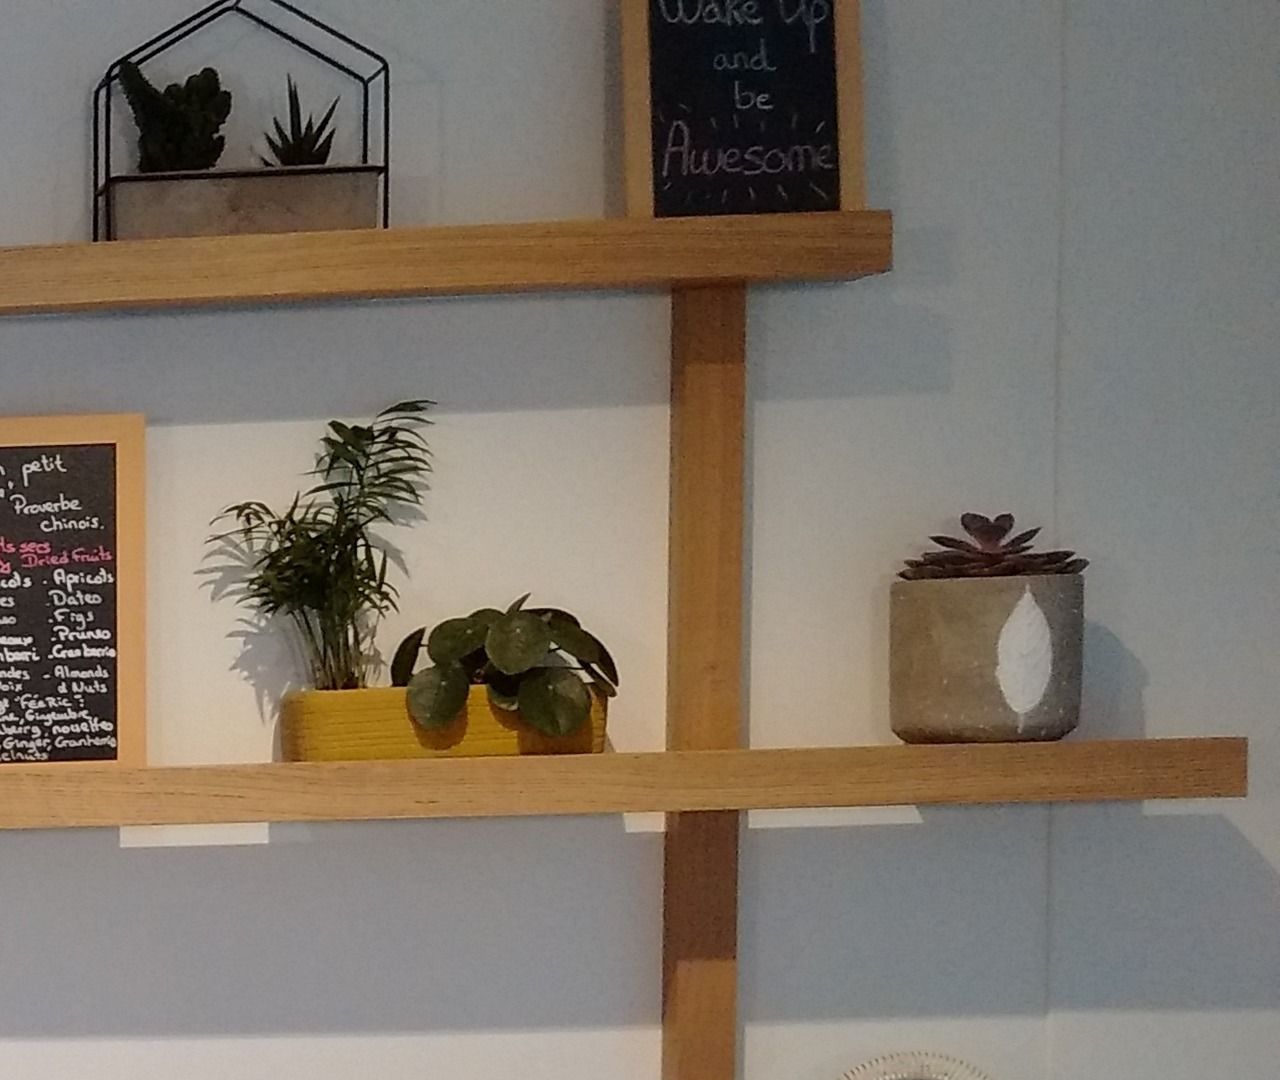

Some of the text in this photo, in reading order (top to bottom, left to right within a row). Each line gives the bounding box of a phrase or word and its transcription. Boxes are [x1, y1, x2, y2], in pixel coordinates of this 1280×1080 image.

[660, 0, 762, 26] Wake
[712, 38, 777, 72] and
[734, 80, 776, 110] be
[662, 119, 834, 177] Awesome
[22, 454, 67, 487] petit
[9, 493, 83, 515] Proverbe
[18, 541, 52, 554] secs
[21, 545, 114, 568] Dried Fruits
[53, 568, 115, 592] Apricots
[53, 608, 95, 631] Figs
[53, 664, 110, 679] Almonds
[71, 681, 108, 694] Nuts
